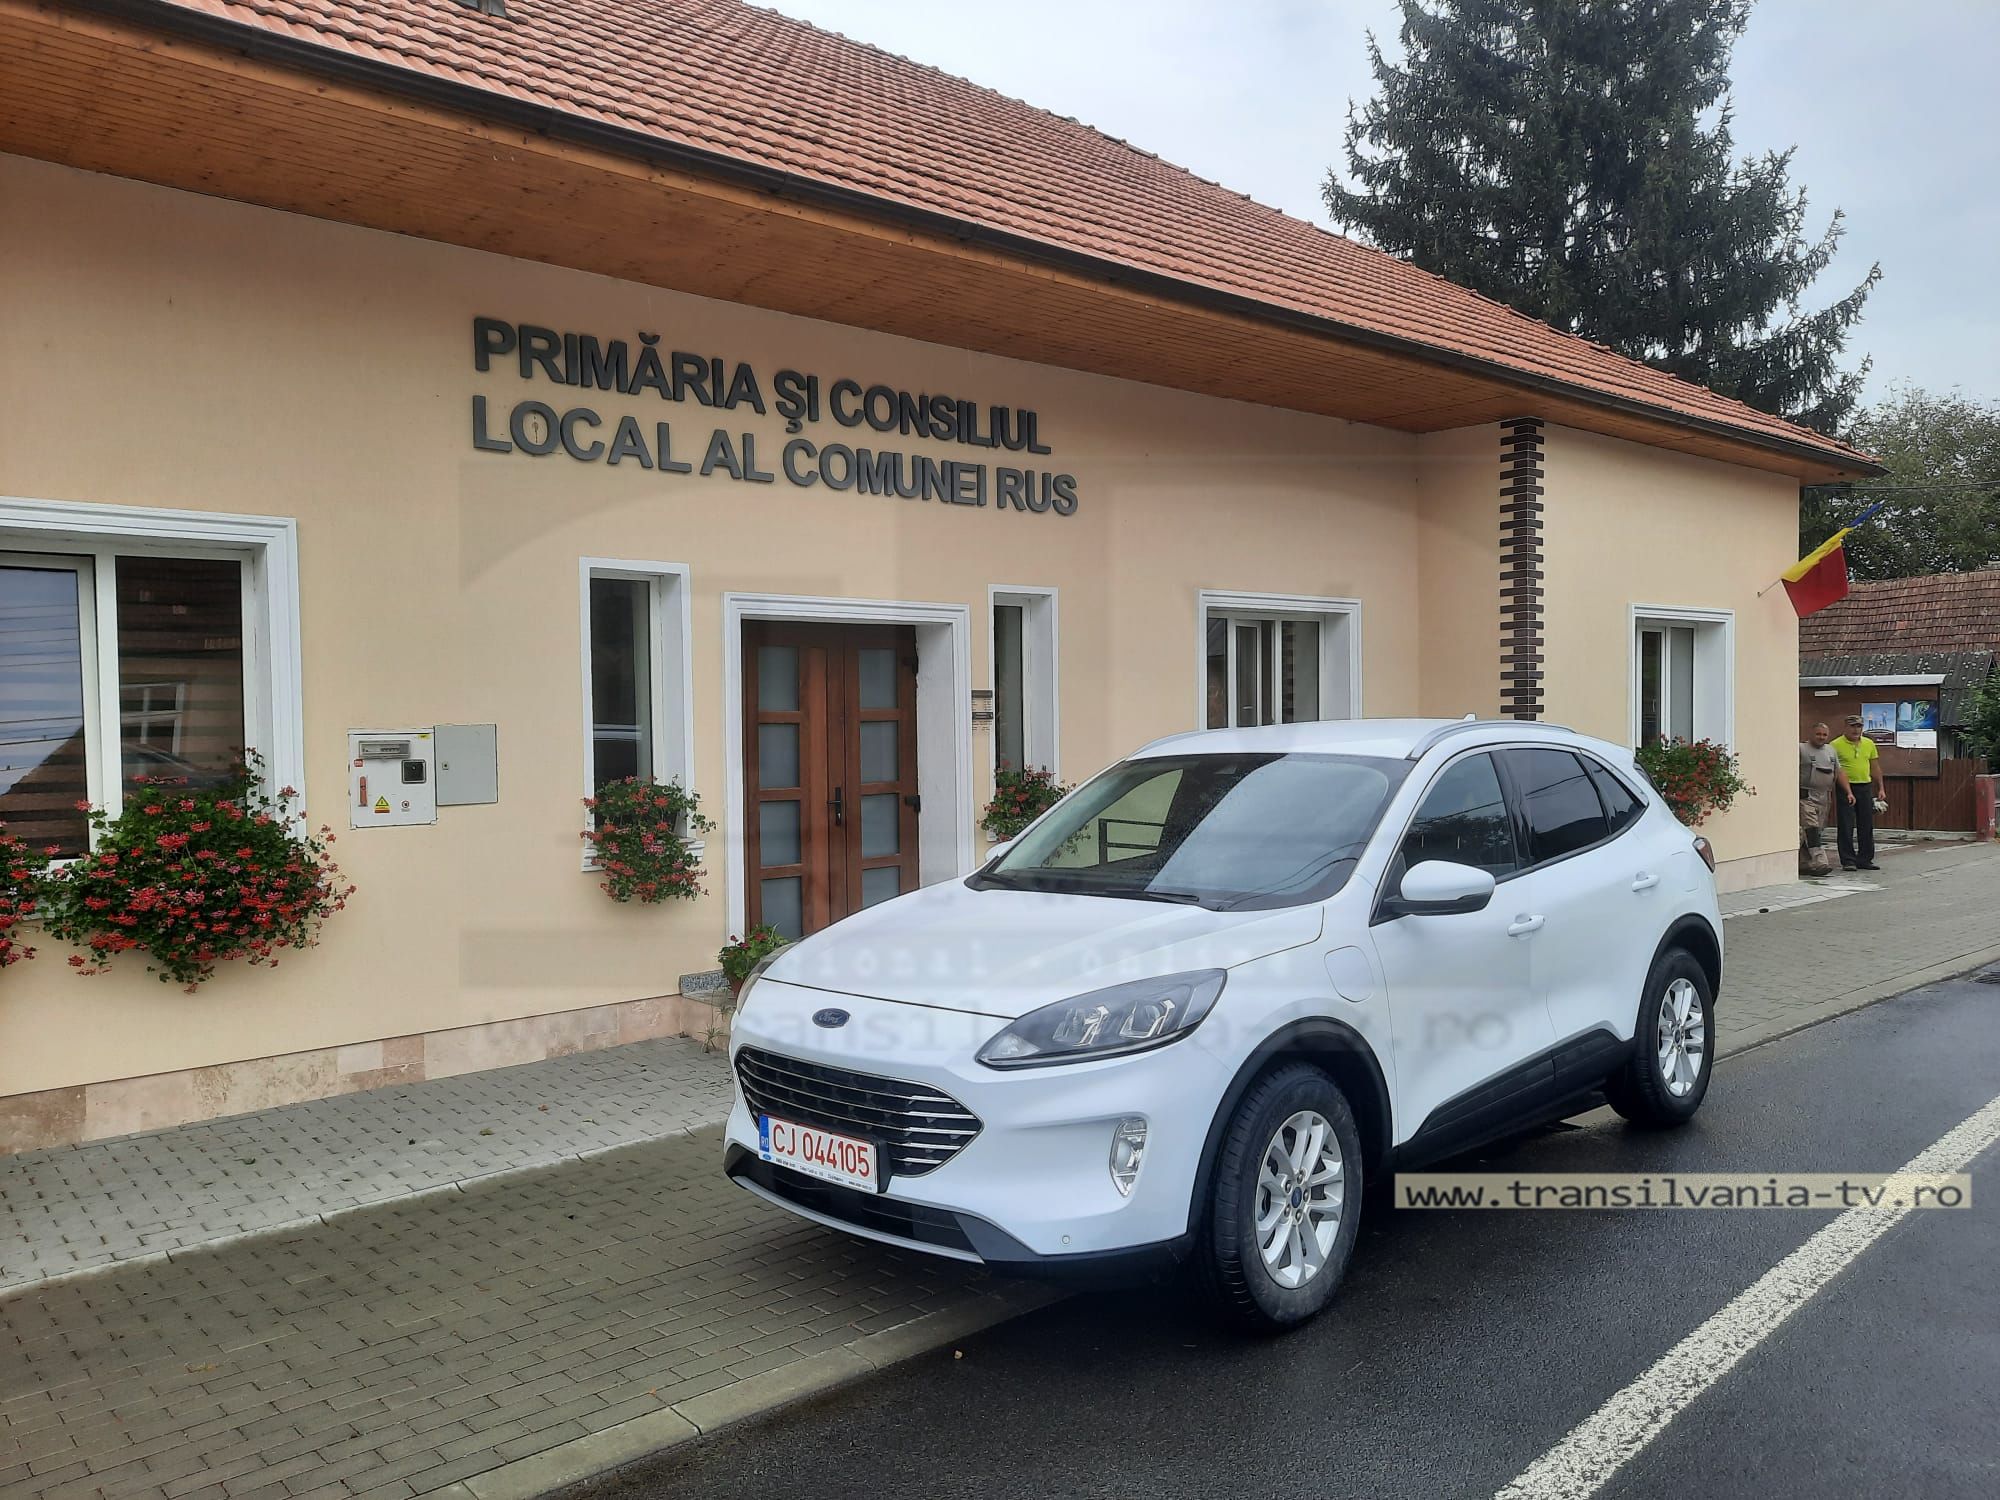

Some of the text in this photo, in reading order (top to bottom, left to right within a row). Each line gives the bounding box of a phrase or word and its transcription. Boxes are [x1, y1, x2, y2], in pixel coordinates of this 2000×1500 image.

[474, 317, 766, 414] PRIMĂRIA
[829, 379, 1051, 454] CONSILIUL
[473, 395, 1078, 516] LOCAL AL COMUNEI RUS
[773, 1123, 797, 1157] CJ
[803, 1131, 870, 1177] 044105
